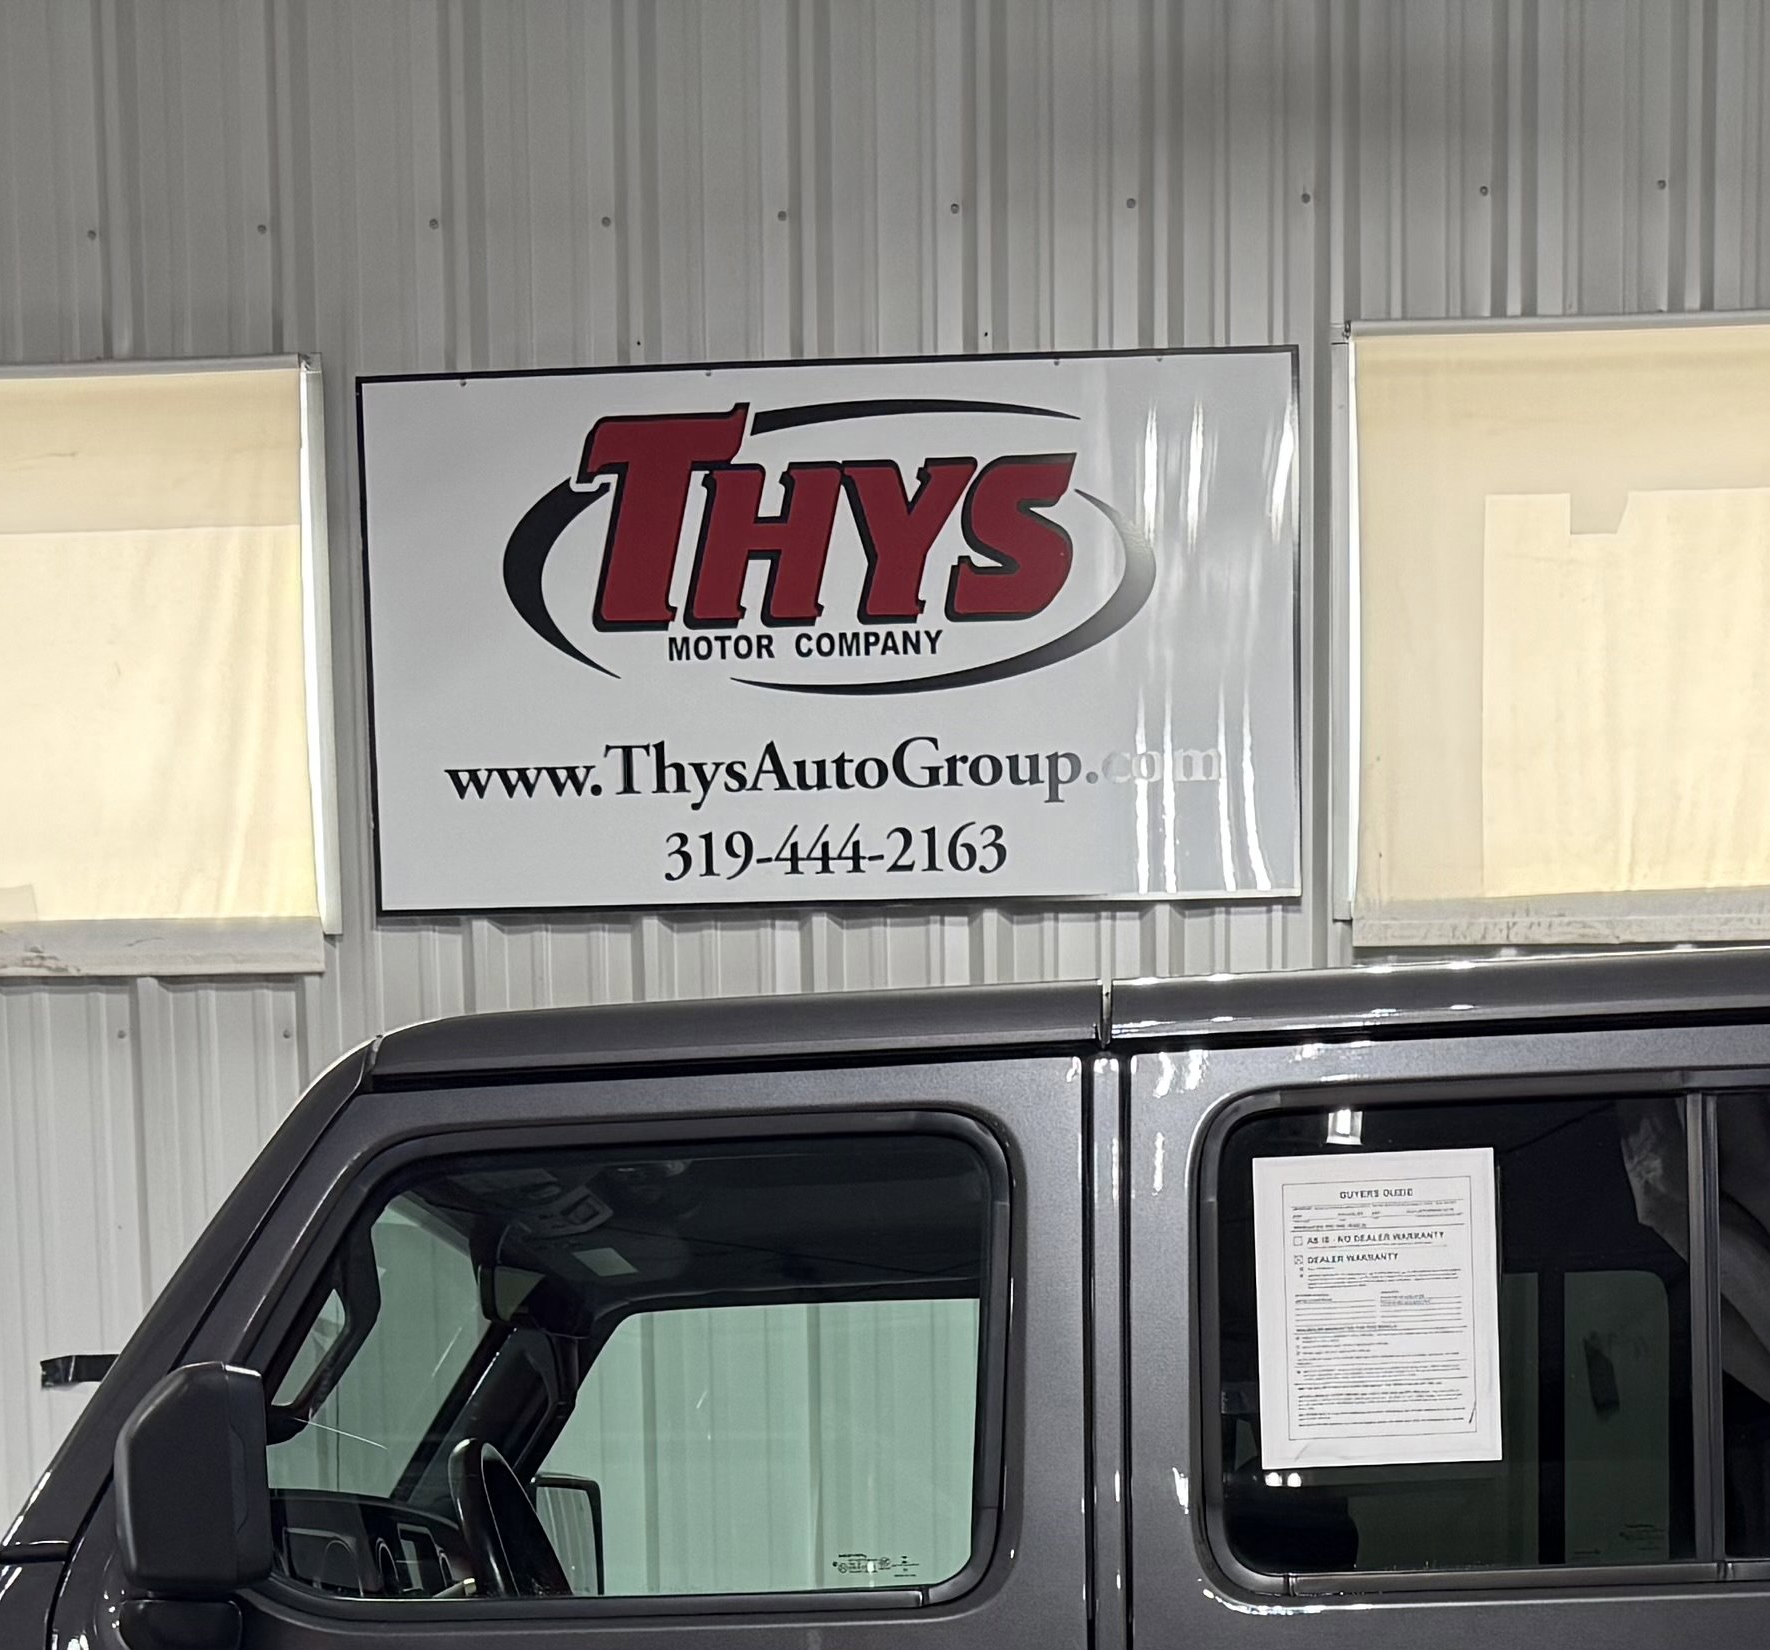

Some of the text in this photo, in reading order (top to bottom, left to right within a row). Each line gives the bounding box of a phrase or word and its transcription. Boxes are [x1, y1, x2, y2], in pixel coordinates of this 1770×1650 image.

[577, 402, 1077, 632] THYS
[668, 630, 943, 662] MOTOR COMPANY
[664, 821, 1007, 882] 319-444-2163
[1354, 1232, 1390, 1242] DEALER
[1392, 1231, 1444, 1241] WARRANTY
[1307, 1253, 1398, 1264] DEALER WARRANTY
